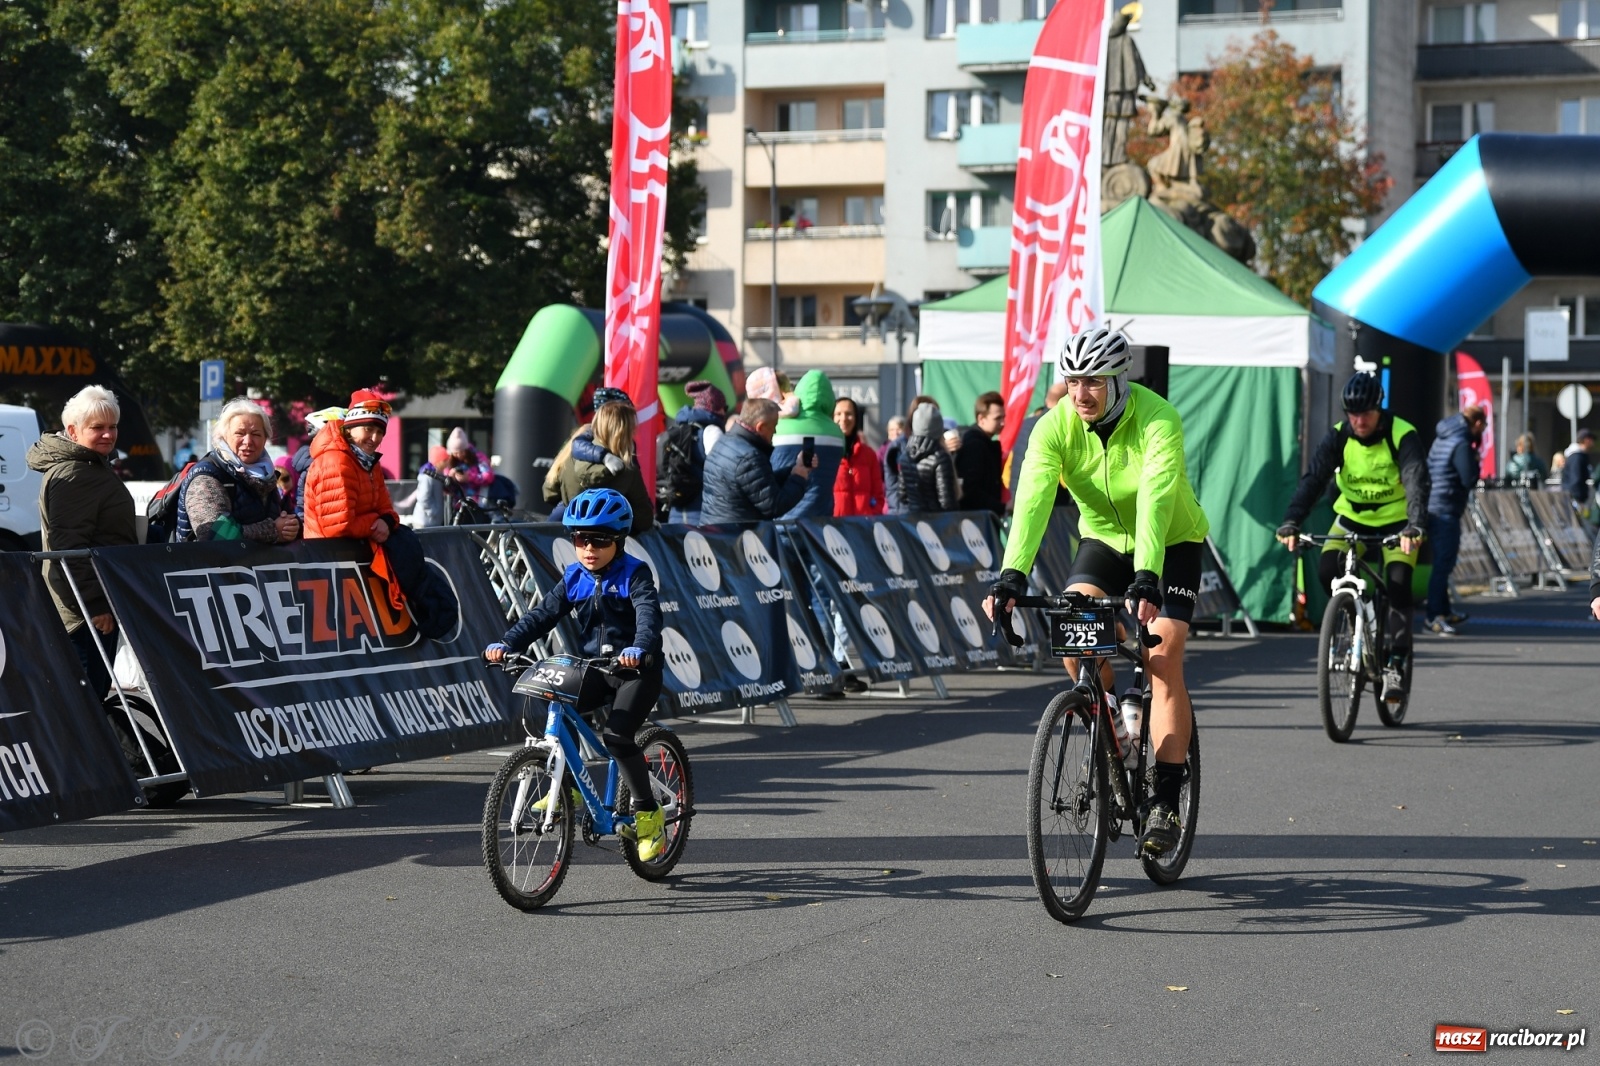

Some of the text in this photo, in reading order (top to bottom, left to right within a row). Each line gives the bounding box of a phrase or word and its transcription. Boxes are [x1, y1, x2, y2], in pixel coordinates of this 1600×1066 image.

[0, 344, 96, 377] MAXXIS
[206, 365, 220, 396] P
[696, 594, 740, 609] KOKOwear
[1059, 622, 1105, 632] OPIEKUN
[1064, 631, 1098, 647] 225
[531, 668, 566, 686] 225
[738, 679, 786, 700] KOKOwear
[678, 691, 721, 708] KOKOwear
[235, 680, 503, 759] USZCZELNIAMY NAJLEPSZYCH
